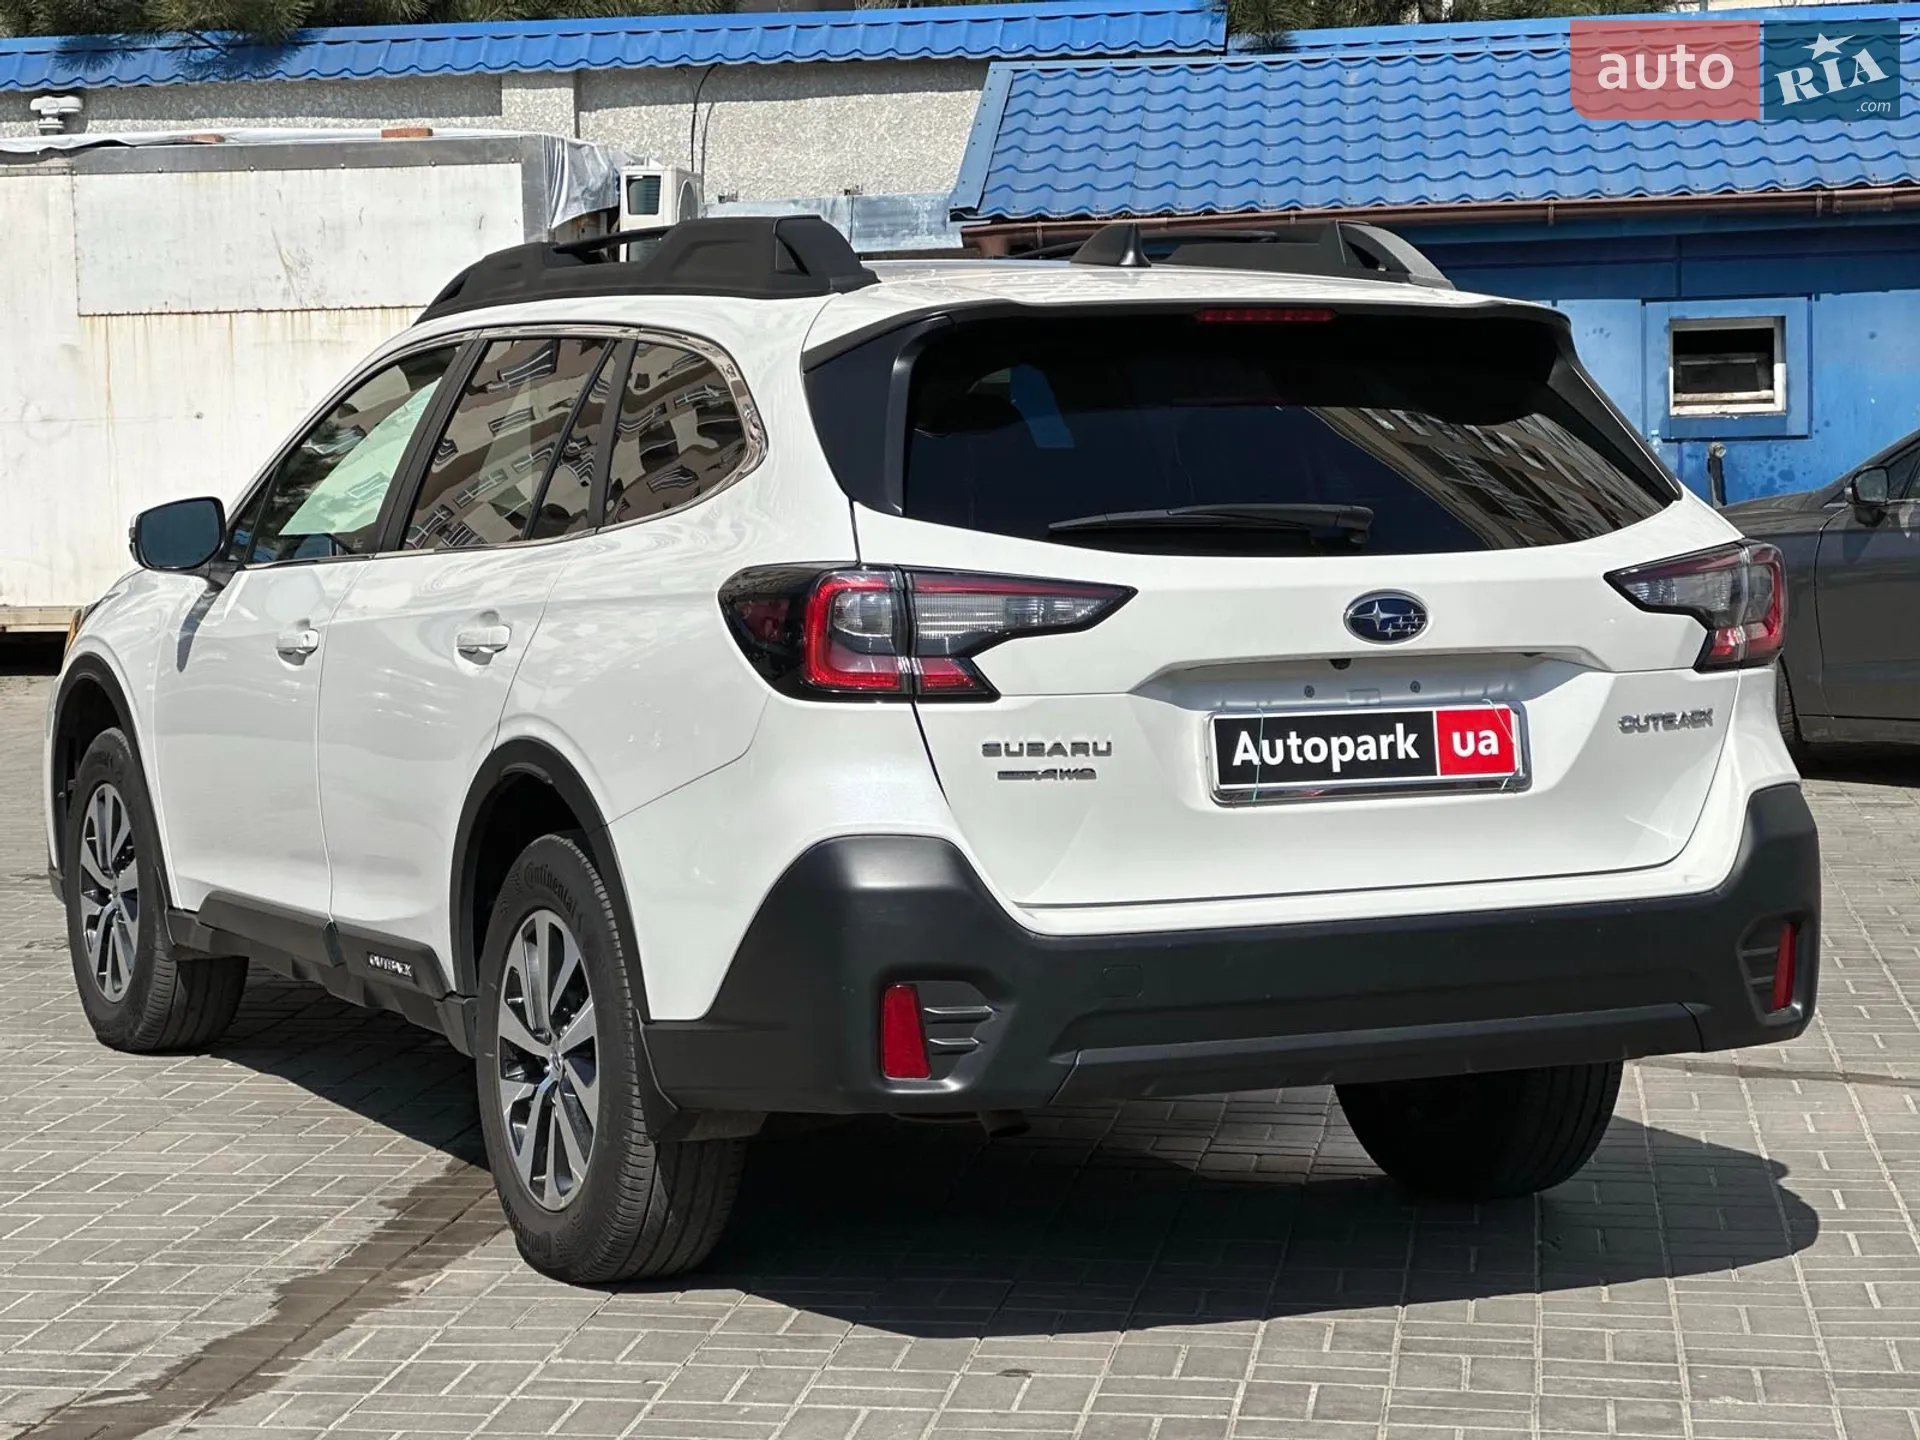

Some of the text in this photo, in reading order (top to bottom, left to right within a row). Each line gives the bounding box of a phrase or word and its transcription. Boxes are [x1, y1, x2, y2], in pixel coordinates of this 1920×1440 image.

[981, 741, 1113, 758] SUBARU
[1231, 723, 1500, 773] Autopark ua
